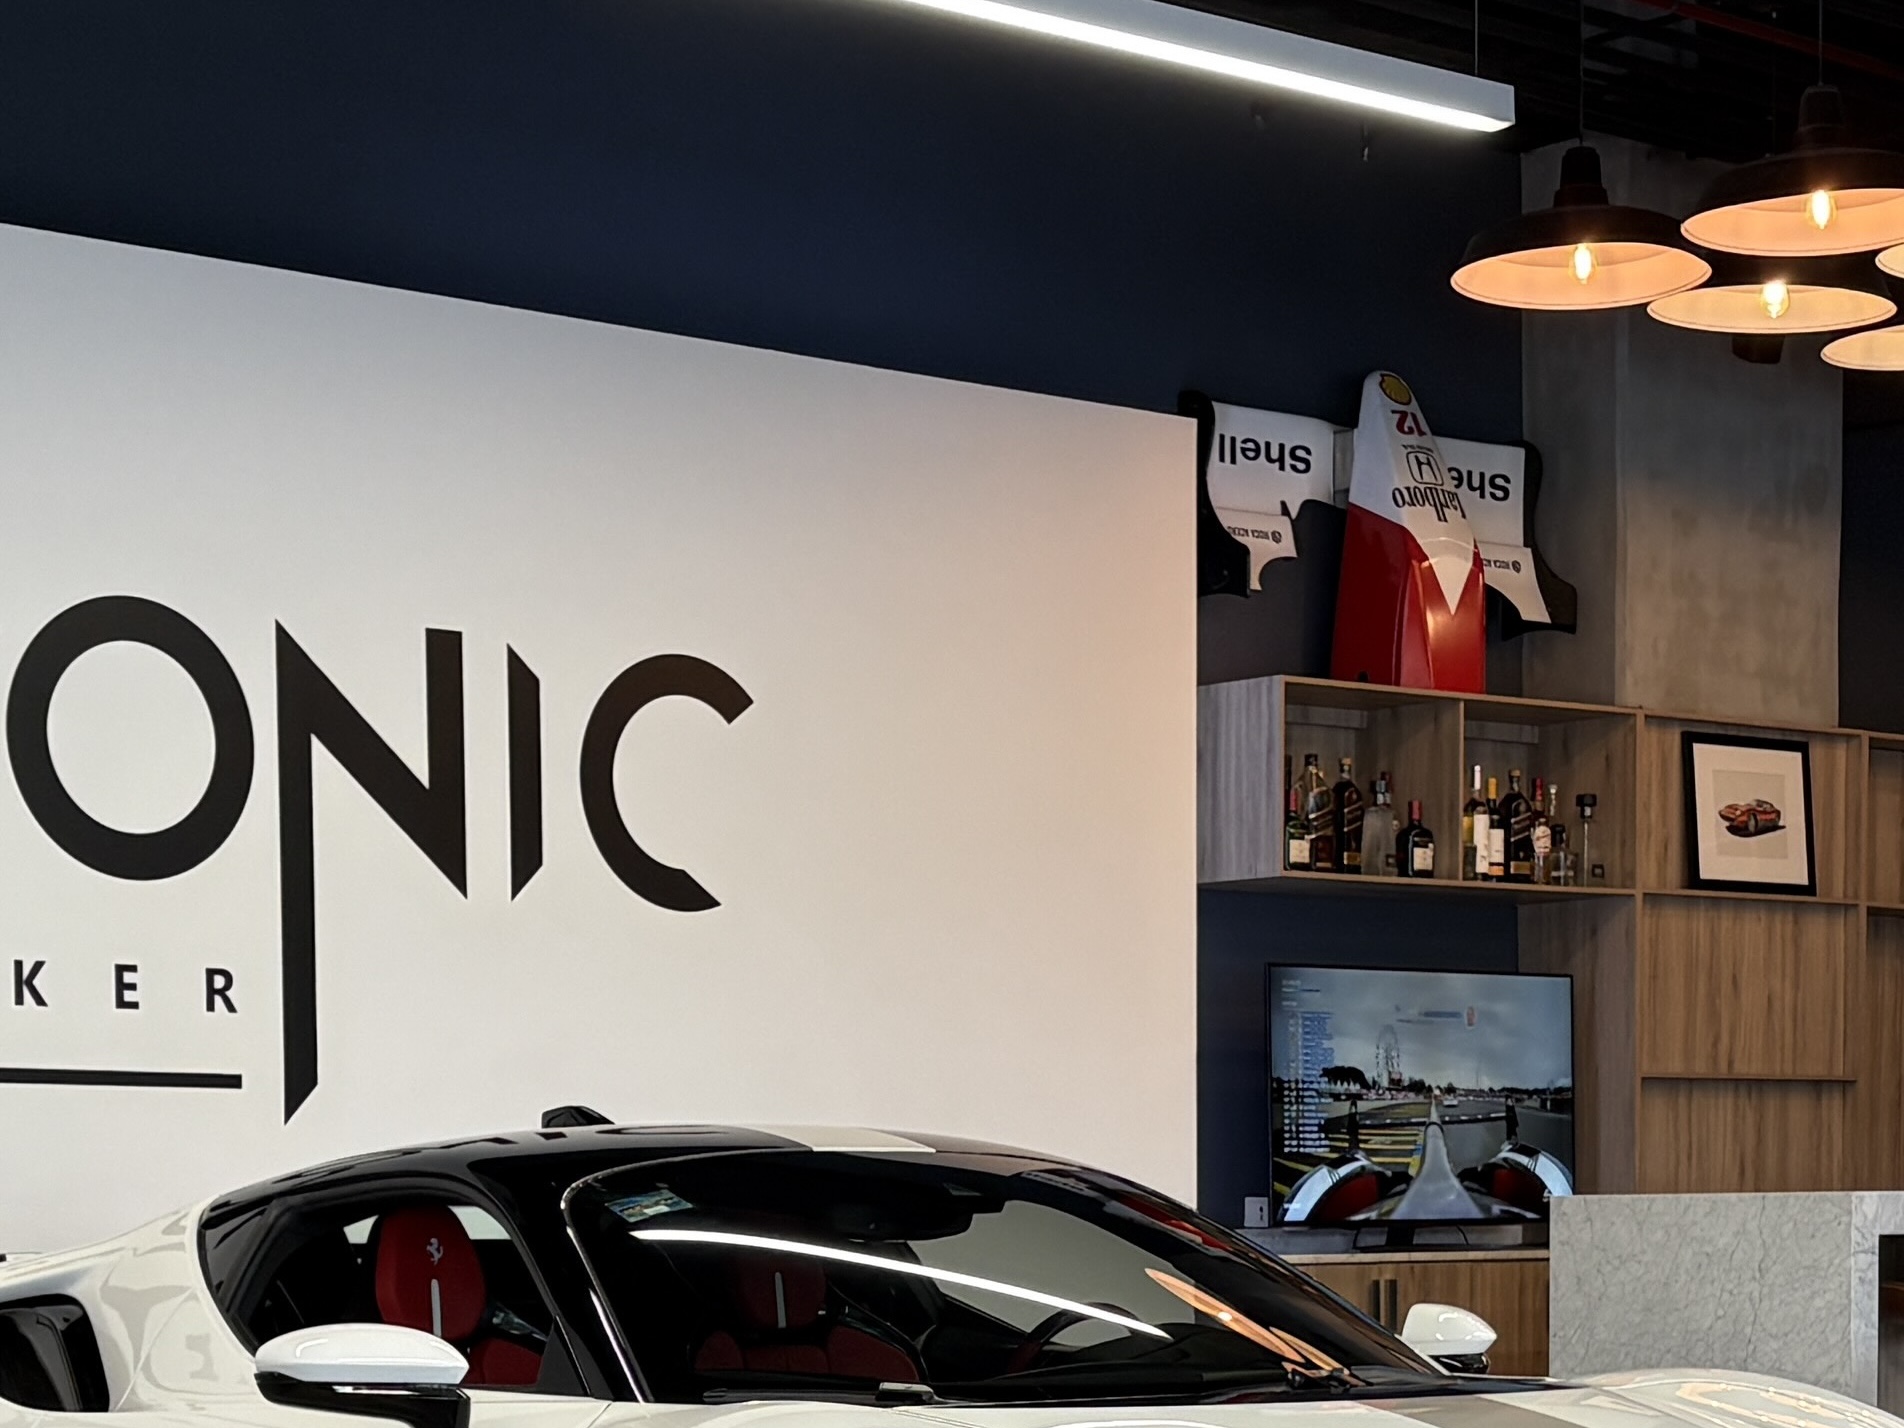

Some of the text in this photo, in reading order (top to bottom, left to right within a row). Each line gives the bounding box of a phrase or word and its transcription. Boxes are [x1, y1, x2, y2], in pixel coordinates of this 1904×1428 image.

[1390, 409, 1427, 437] 12
[1218, 433, 1312, 474] Shell
[1446, 466, 1512, 502] She
